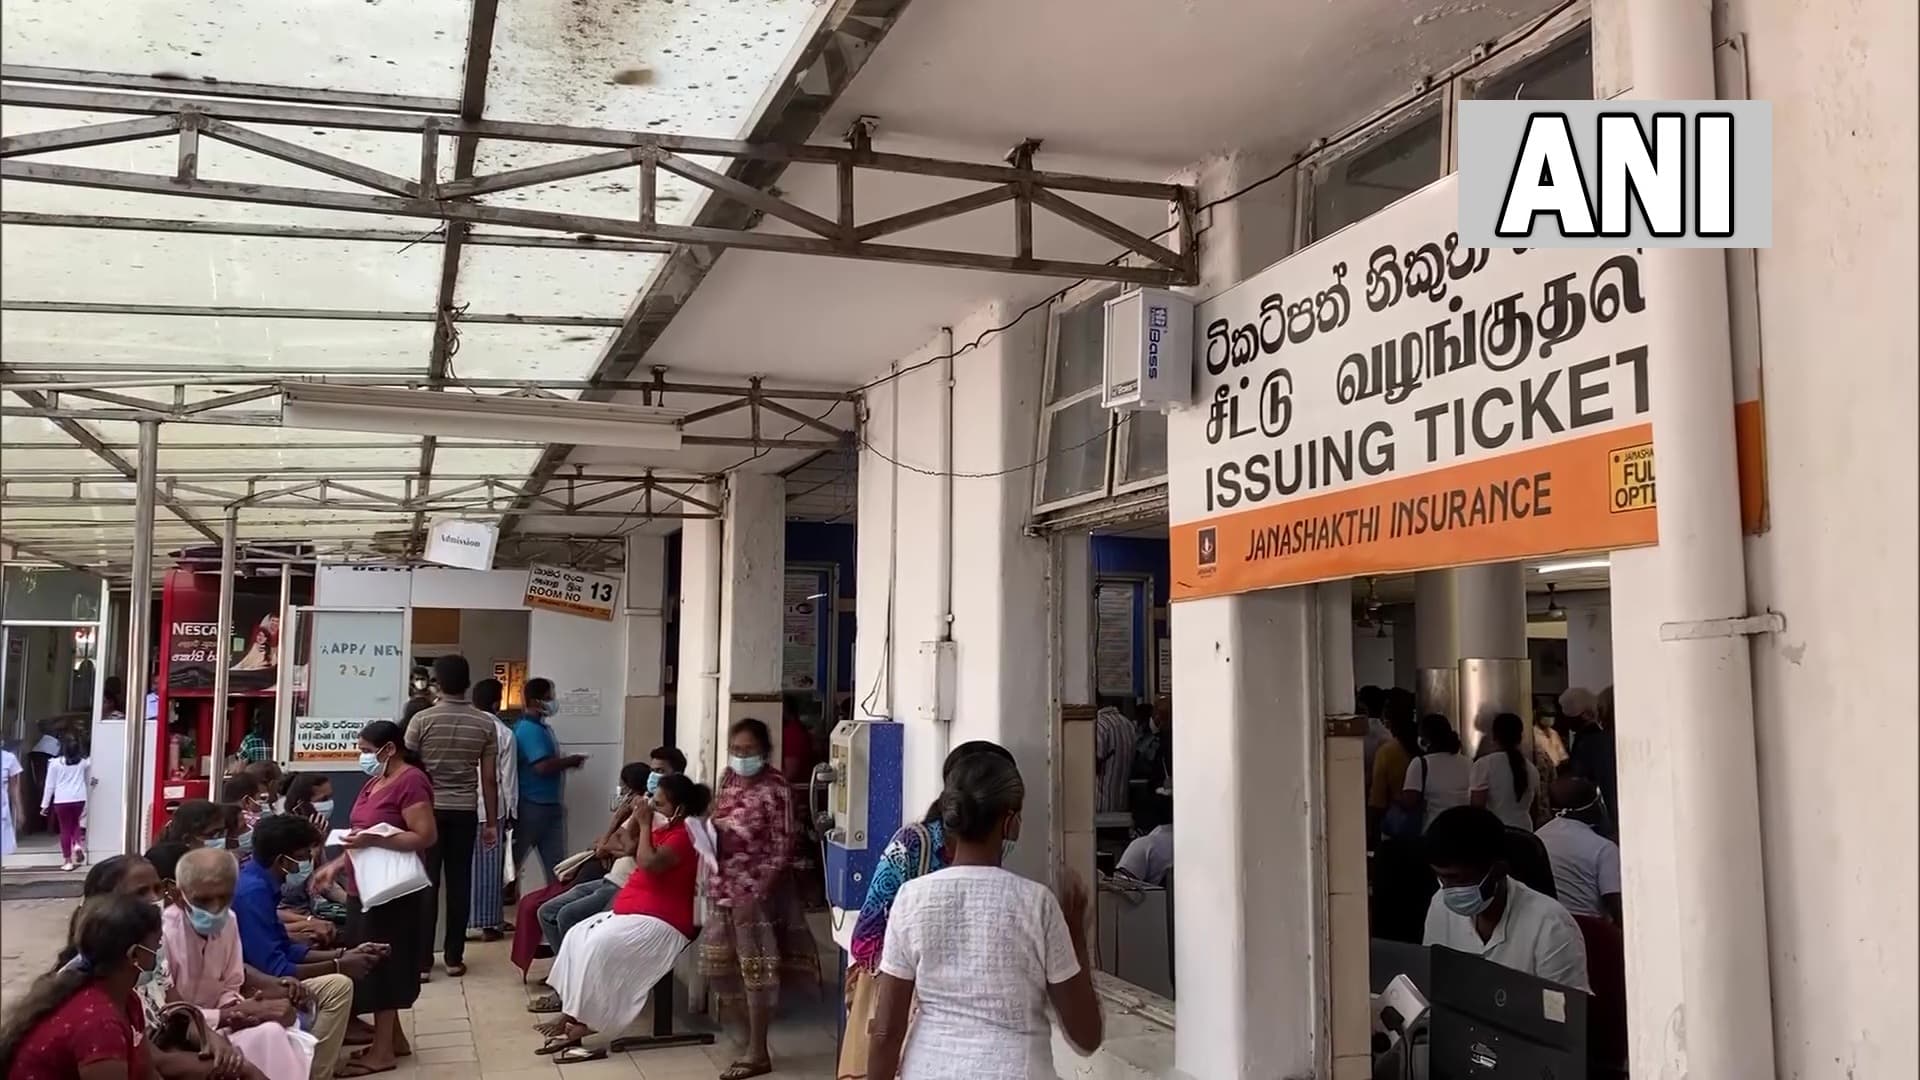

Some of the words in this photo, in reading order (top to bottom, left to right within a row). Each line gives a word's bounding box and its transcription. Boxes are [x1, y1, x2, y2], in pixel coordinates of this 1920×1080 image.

[1149, 328, 1161, 379] Bass
[1206, 367, 1293, 445] சீட்டு
[1337, 254, 1647, 405] வழங்குதல
[1206, 420, 1395, 512] ISSUING
[1244, 505, 1381, 562] JANASHAKTHI
[1389, 472, 1553, 540] INSURANCE
[441, 533, 481, 548] Admission
[529, 586, 562, 599] ROOM
[565, 592, 581, 602] NO
[591, 582, 612, 602] 13
[302, 742, 347, 751] VISION
